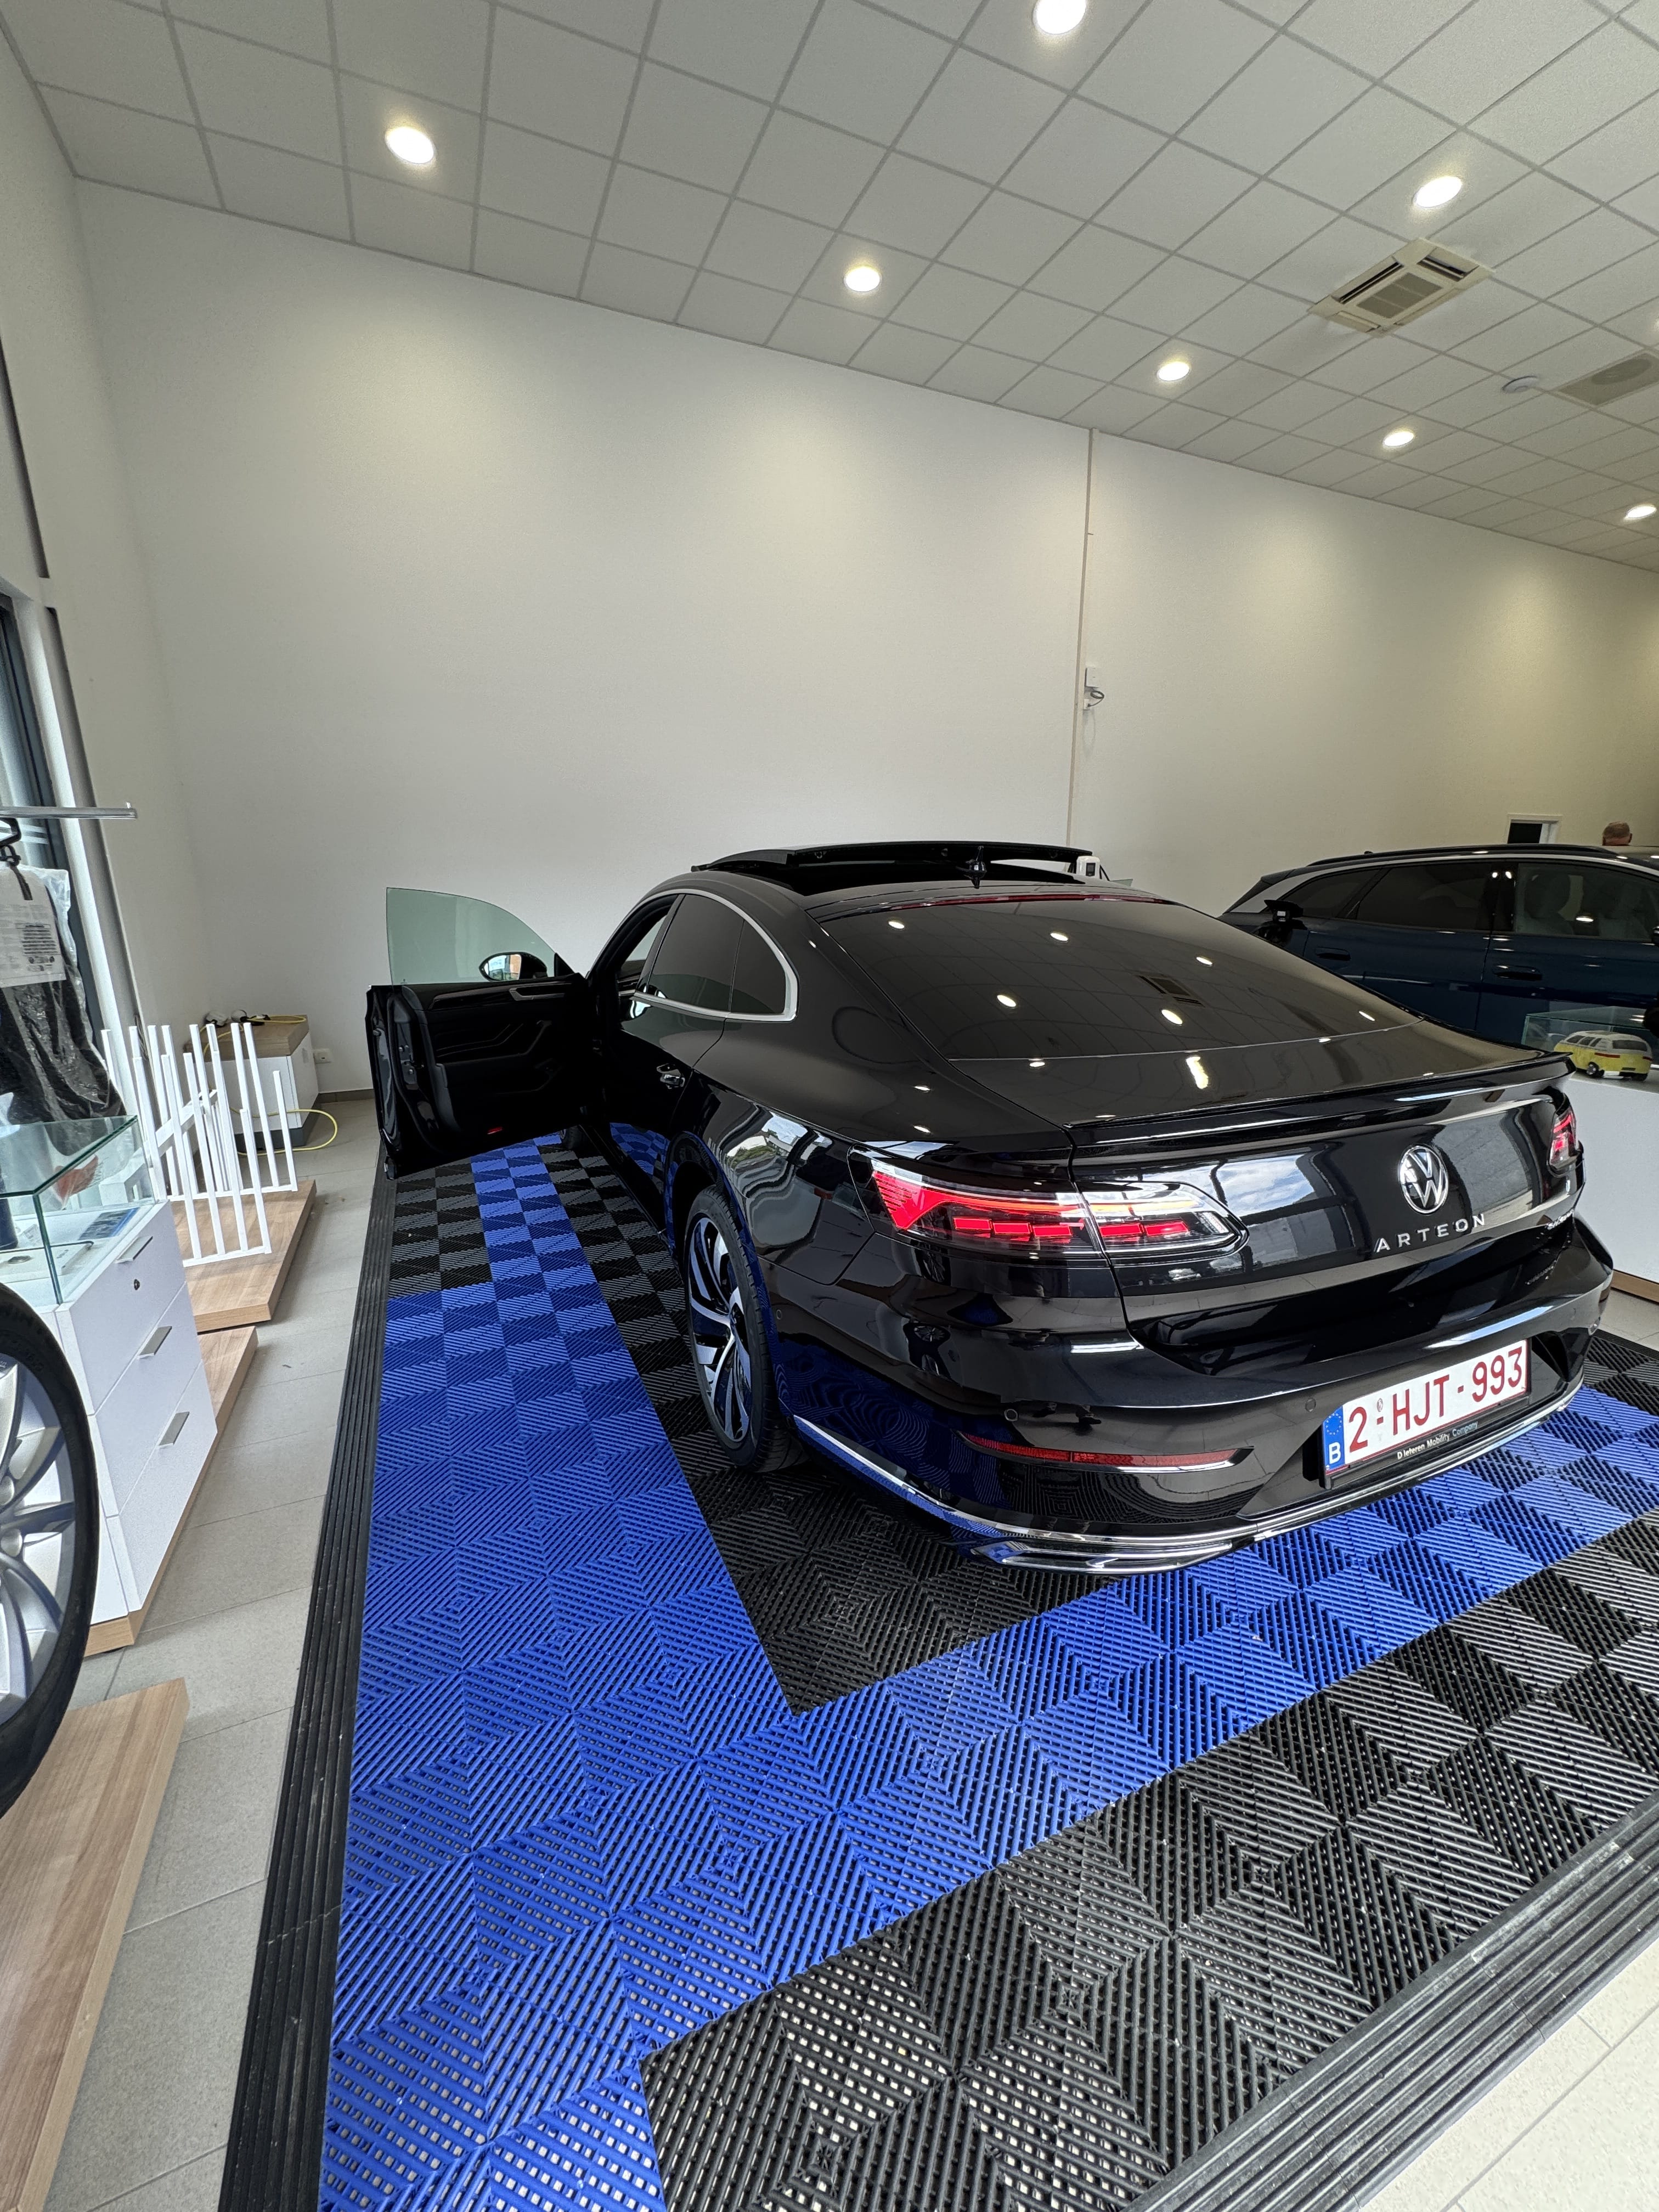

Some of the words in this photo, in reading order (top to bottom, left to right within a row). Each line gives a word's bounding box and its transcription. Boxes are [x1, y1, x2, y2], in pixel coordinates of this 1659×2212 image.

[1374, 1214, 1485, 1252] ARTEON
[1348, 1346, 1523, 1453] 2-HJT-993
[1426, 1432, 1450, 1448] Mobility
[1452, 1421, 1478, 1437] Company
[1328, 1442, 1341, 1464] B
